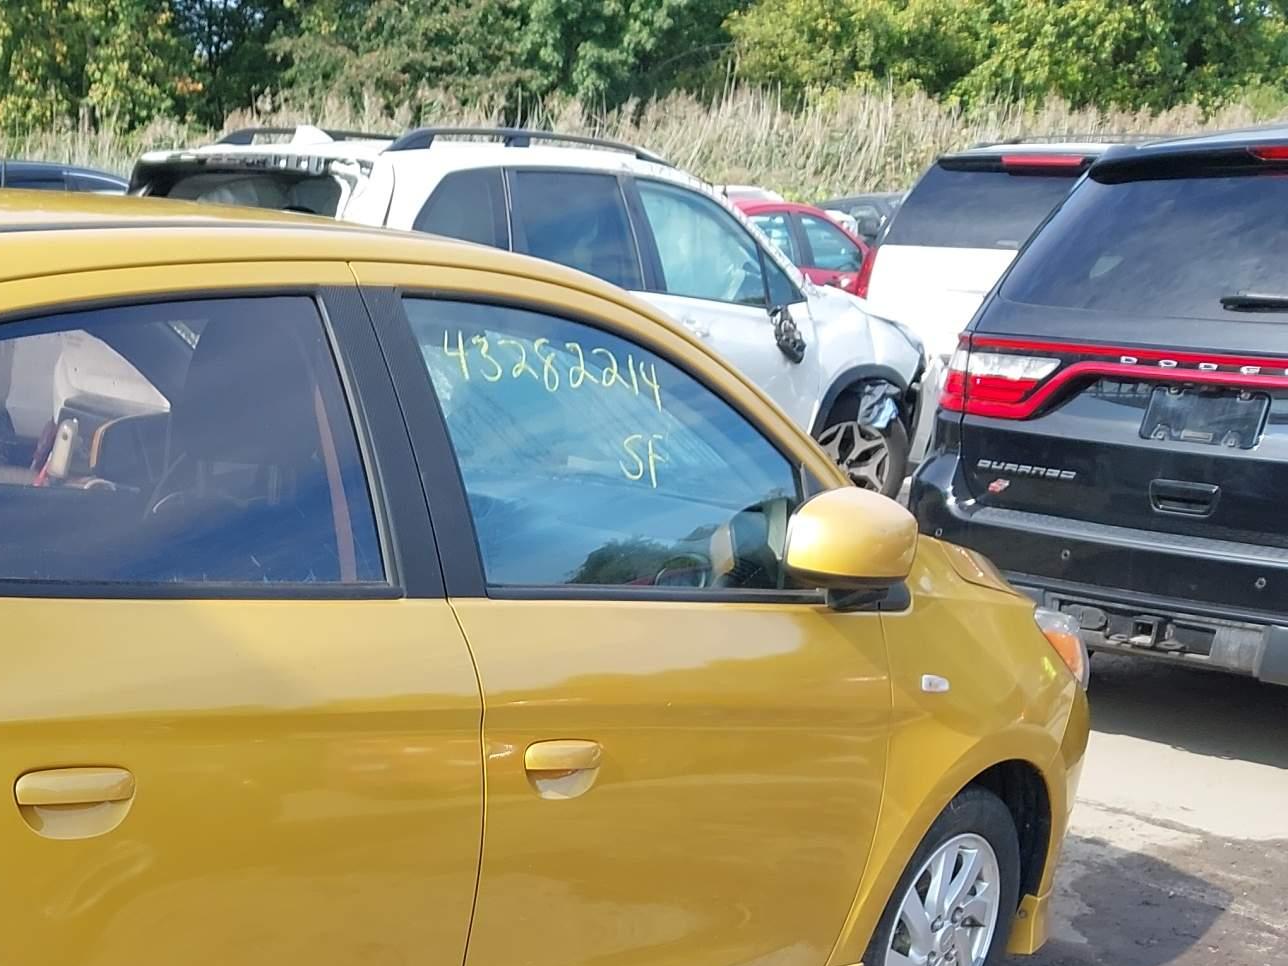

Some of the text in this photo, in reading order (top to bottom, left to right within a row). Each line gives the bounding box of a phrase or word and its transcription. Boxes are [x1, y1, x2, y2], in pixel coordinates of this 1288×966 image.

[443, 329, 662, 412] 43282214
[1120, 355, 1288, 376] DODG
[619, 433, 670, 488] SF
[977, 459, 1076, 479] DURANGO
